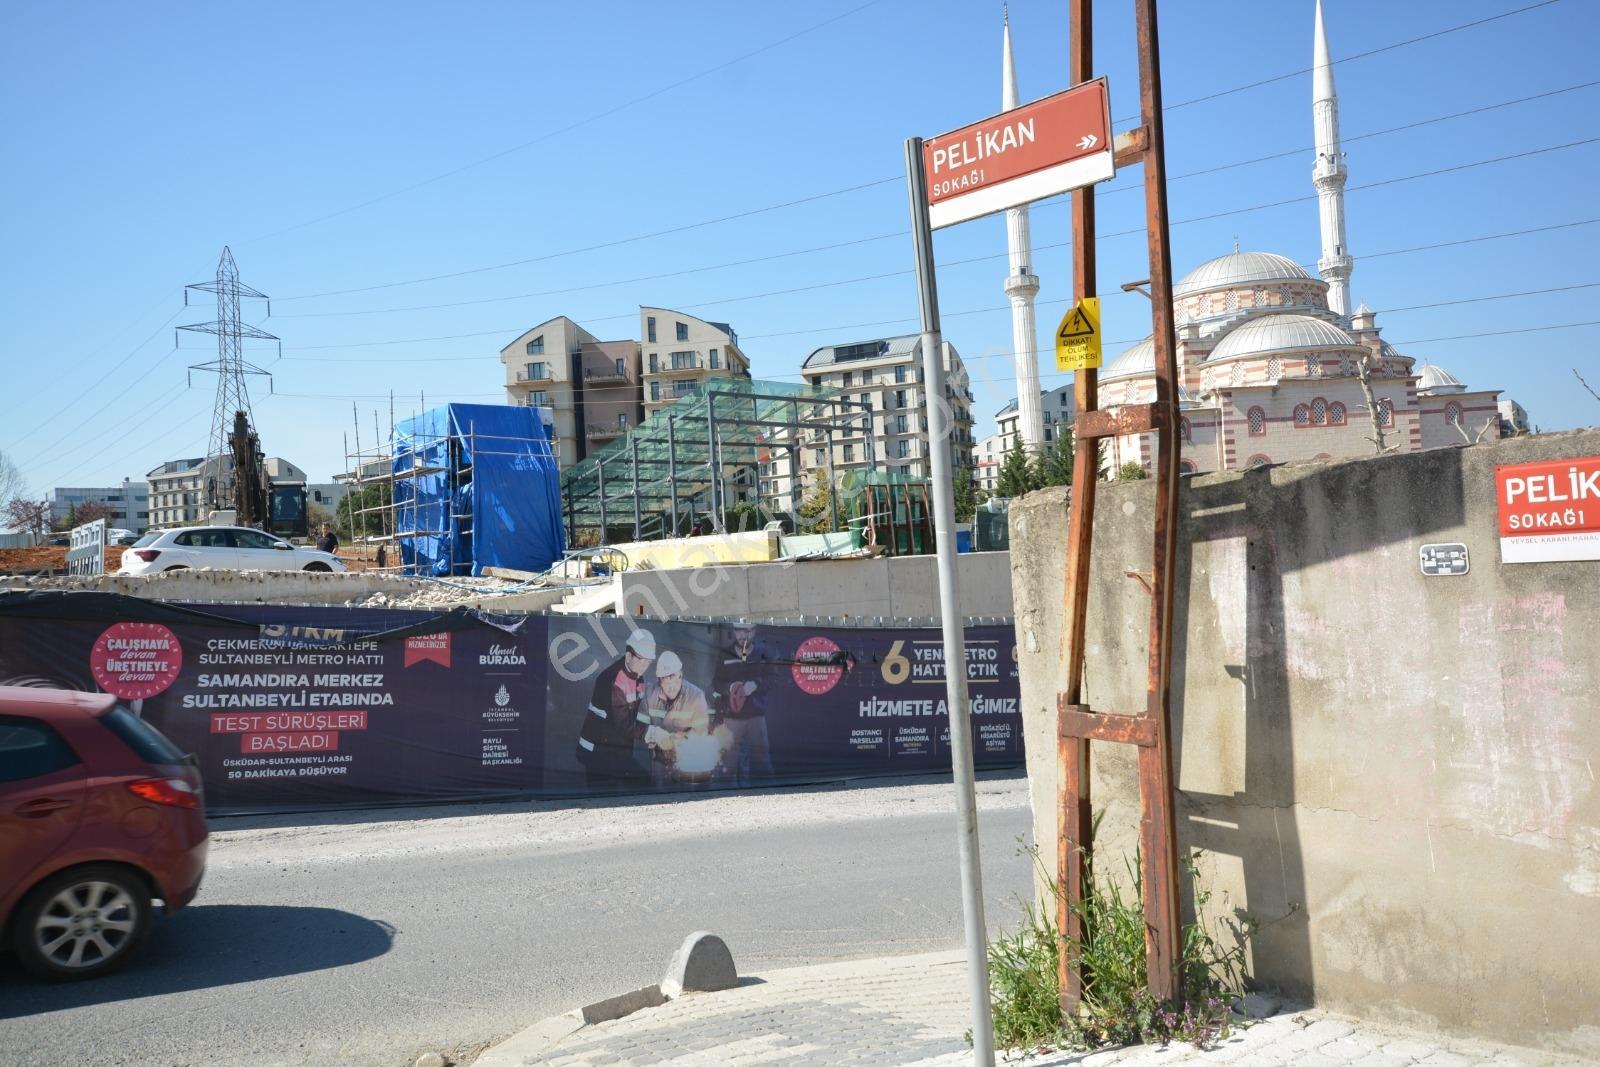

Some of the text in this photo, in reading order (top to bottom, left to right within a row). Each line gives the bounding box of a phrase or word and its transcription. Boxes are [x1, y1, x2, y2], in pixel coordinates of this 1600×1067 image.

[933, 118, 1036, 174] PELİKAN
[933, 169, 985, 197] SOKAĞI
[1509, 508, 1585, 529] SOKAĞI
[1510, 537, 1538, 545] VEYSEL
[107, 638, 170, 651] ÇALIŞMAYA
[489, 644, 518, 655] Umut
[120, 648, 156, 659] devam
[199, 651, 384, 665] SULTANBEYLİ METRO HATTI
[479, 655, 527, 665] BURADA
[106, 658, 169, 672] ÜRETMEYE
[880, 640, 910, 685] 6
[118, 670, 155, 681] devam
[197, 673, 384, 688] SAMANDIRA MERKEZ
[182, 689, 306, 709] SULTANBEYLİ
[309, 692, 394, 706] ETABINDA
[859, 696, 933, 717] HİZMETE
[214, 712, 365, 731] TEST SÜRÜŞLERİ
[251, 734, 329, 752] BAŞLADI
[327, 755, 353, 763] ARASI
[228, 765, 348, 779] 50 DAKİKAYA DÜŞÜYOR
